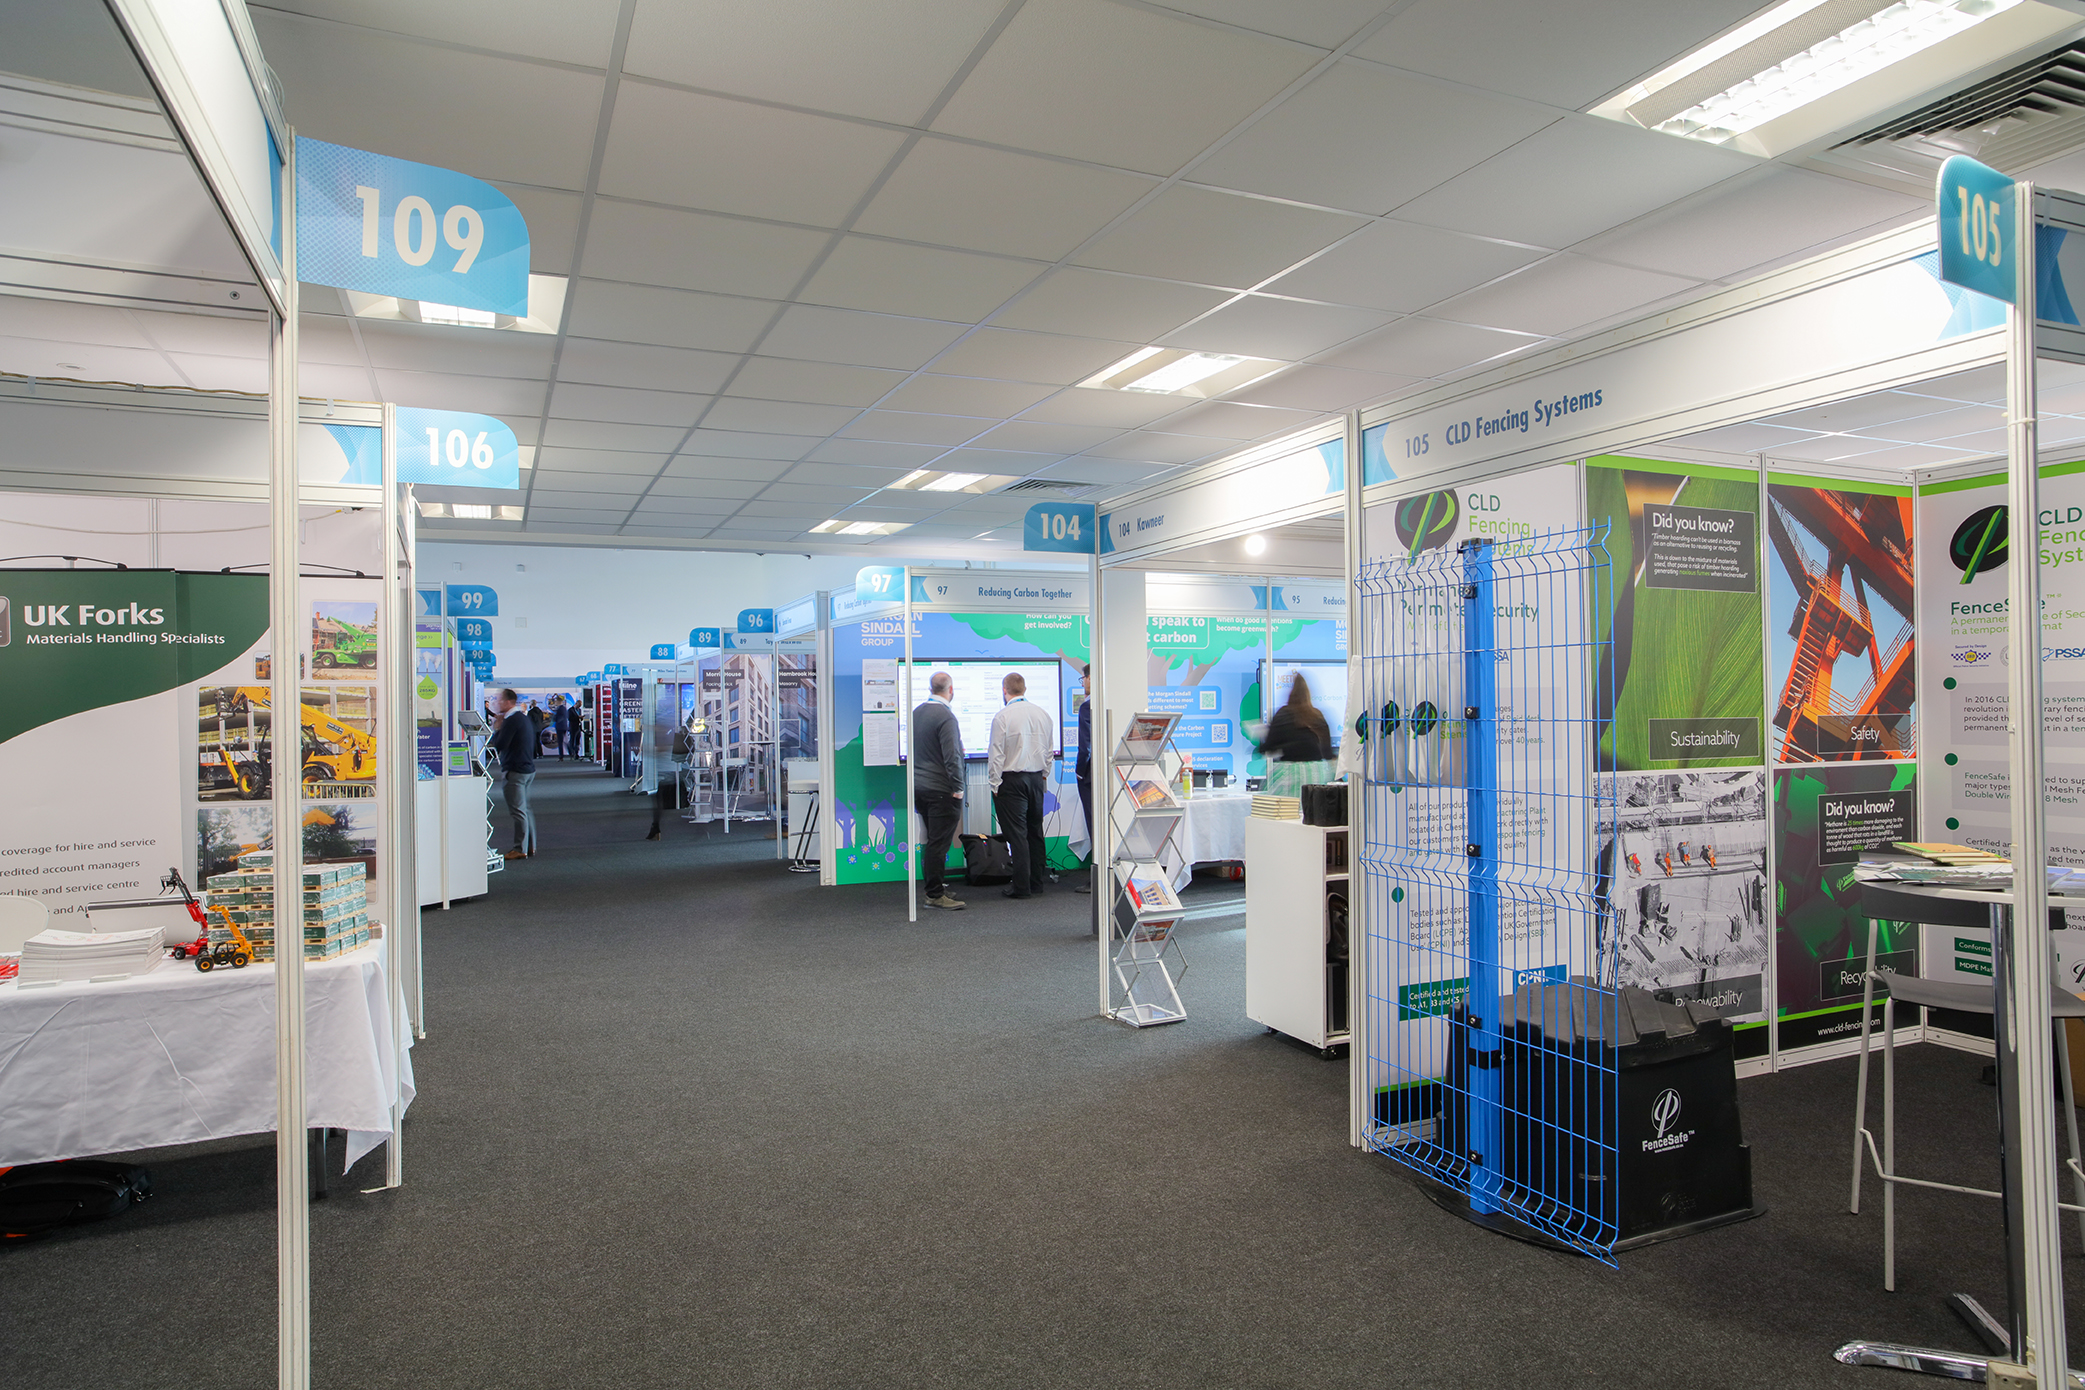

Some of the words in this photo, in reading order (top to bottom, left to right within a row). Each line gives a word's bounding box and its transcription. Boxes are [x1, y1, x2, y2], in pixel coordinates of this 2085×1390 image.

[356, 185, 484, 274] 109
[1958, 186, 2001, 266] 105
[1406, 434, 1429, 458] 105
[1446, 422, 1471, 445] CLD
[1476, 409, 1528, 438] Fencing
[1534, 389, 1603, 427] Systems
[426, 427, 494, 469] 106
[1468, 493, 1500, 511] CLD
[1653, 513, 1672, 528] Did
[1675, 519, 1696, 533] you
[1698, 515, 1734, 533] know?
[2039, 507, 2082, 525] CLD
[1041, 513, 1080, 540] 104
[1119, 522, 1130, 537] 104
[1469, 515, 1530, 538] Fencing
[1671, 534, 1690, 542] hoarding
[871, 574, 892, 592] 97
[462, 592, 483, 608] 99
[938, 586, 948, 595] 97
[978, 587, 1011, 599] Reducing
[1014, 588, 1039, 597] Carbon
[1042, 589, 1072, 600] Together
[1292, 596, 1300, 604] 95
[24, 605, 71, 626] UK
[79, 602, 165, 625] Forks
[1493, 603, 1538, 622] ecurity
[1951, 617, 1958, 625] A
[2051, 610, 2062, 619] of
[748, 614, 763, 627] 96
[861, 622, 921, 633] SINDAL
[1152, 617, 1189, 629] speak
[1192, 617, 1205, 626] to
[467, 624, 482, 636] 98
[699, 632, 711, 642] 89
[1154, 631, 1197, 642] carbon
[1951, 627, 1959, 635] in
[27, 633, 93, 644] Materials
[96, 632, 156, 645] Handling
[161, 632, 225, 644] Specialists
[472, 650, 483, 659] 90
[658, 648, 668, 656] 88
[1671, 730, 1740, 748] Sustainability
[1851, 725, 1880, 743] Safety
[1965, 772, 2005, 780] FenceSafe
[1965, 791, 1994, 799] Double
[2053, 795, 2078, 803] Mesh
[1826, 801, 1842, 816] Did
[1845, 804, 1862, 819] you
[1864, 799, 1895, 813] know?
[1, 845, 51, 856] coverage
[56, 844, 70, 852] for
[74, 843, 94, 851] hire
[98, 840, 117, 849] and
[120, 839, 156, 847] service
[1966, 838, 2000, 847] Certified
[2062, 846, 2078, 854] the
[43, 864, 84, 874] account
[88, 860, 140, 870] managers
[17, 888, 38, 896] hire
[66, 883, 103, 893] service
[107, 880, 139, 889] centre
[54, 906, 73, 914] and
[1411, 909, 1433, 917] Tested
[1436, 906, 1448, 915] and
[1959, 962, 1979, 970] MDPE
[1409, 990, 1435, 1000] Certified
[1437, 988, 1447, 997] and
[1449, 986, 1469, 994] tested
[1642, 1132, 1688, 1151] FenceSafe
